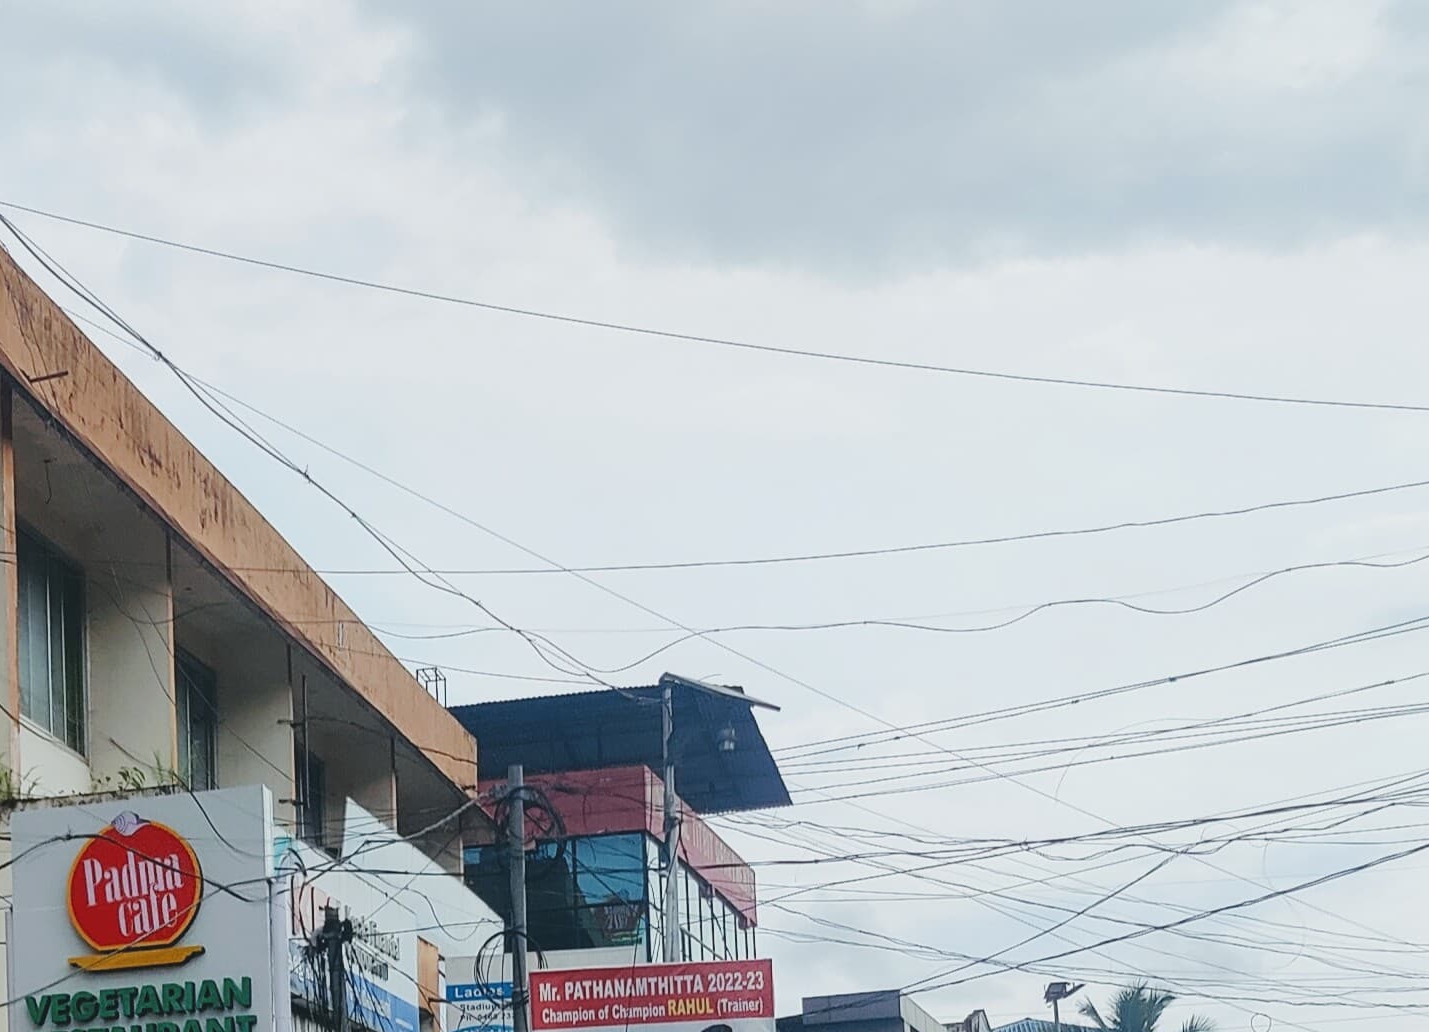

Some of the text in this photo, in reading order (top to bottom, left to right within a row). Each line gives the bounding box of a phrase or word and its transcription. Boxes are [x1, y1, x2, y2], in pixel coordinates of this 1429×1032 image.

[83, 850, 184, 908] Padma
[118, 884, 178, 937] cafe
[25, 976, 253, 1027] VEGETARIAN
[539, 971, 764, 1002] Mr. PATHANAMTHITTA 2022-23
[542, 997, 764, 1025] Champion of Champion RAHUL (Trainer)
